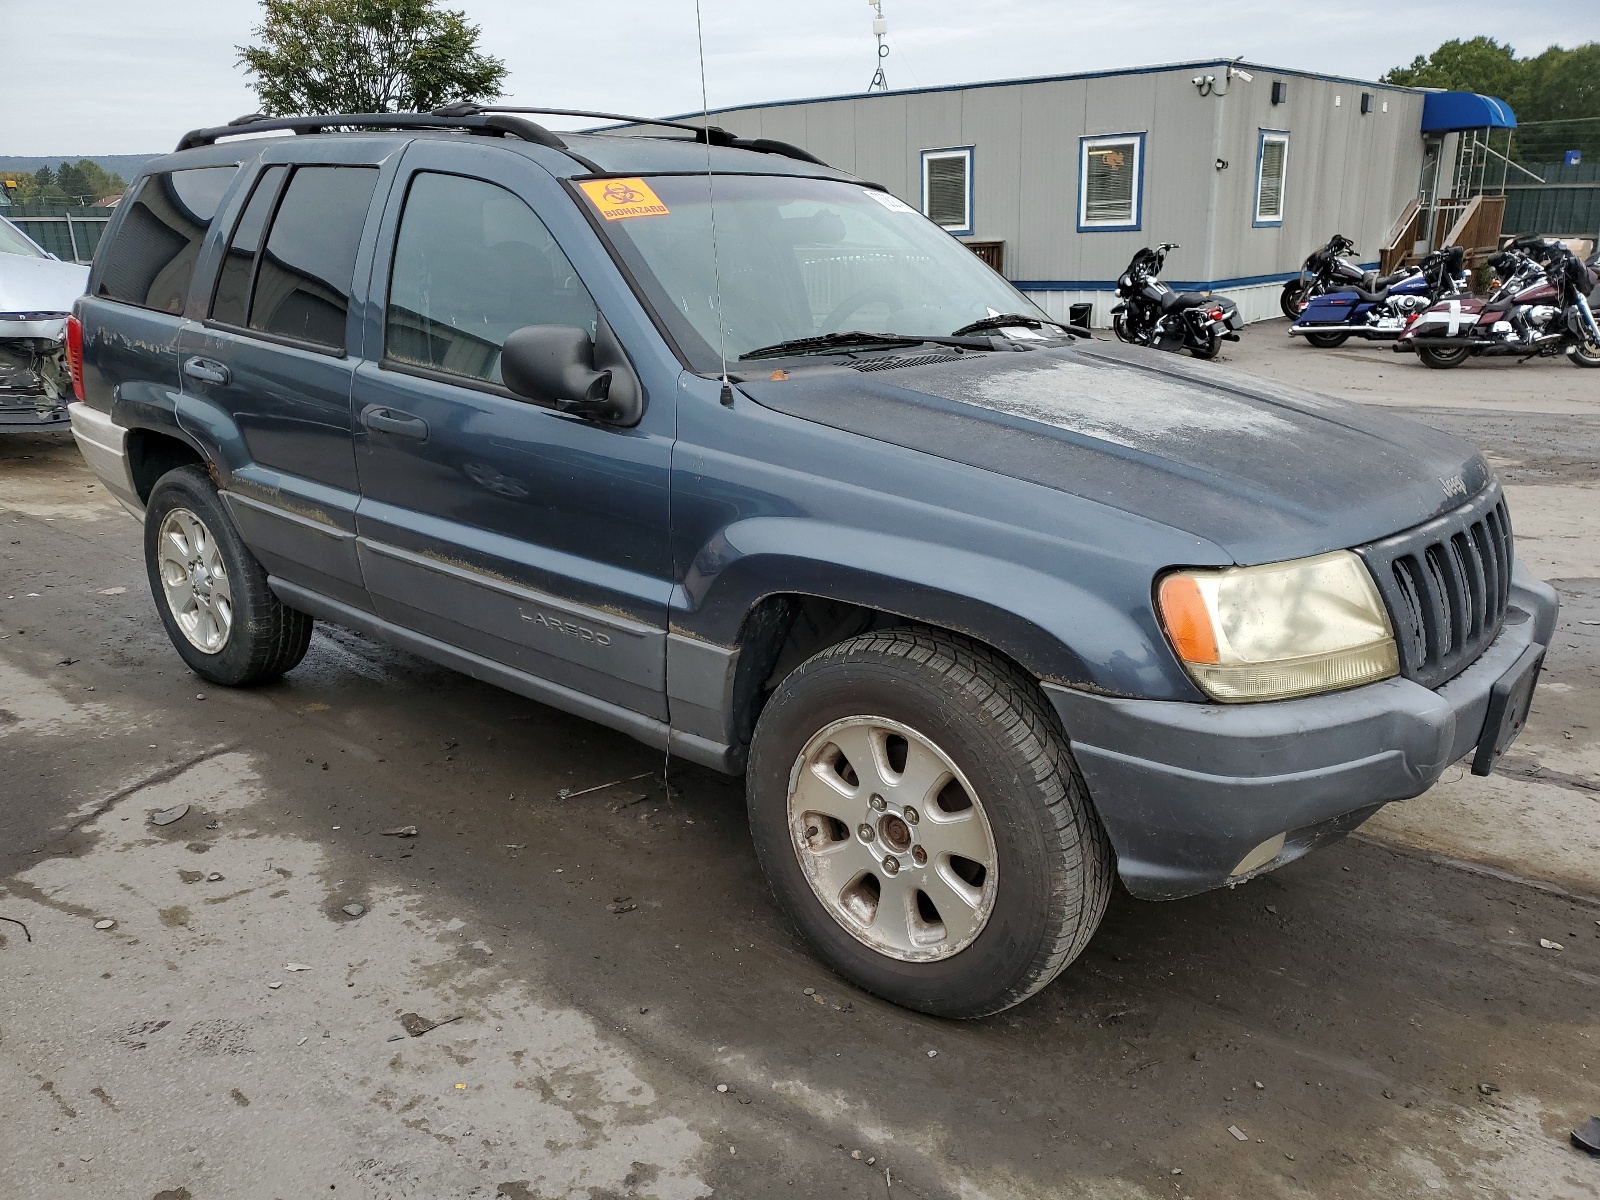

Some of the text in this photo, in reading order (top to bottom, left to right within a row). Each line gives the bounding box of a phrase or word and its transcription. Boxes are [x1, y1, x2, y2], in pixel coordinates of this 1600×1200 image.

[604, 205, 667, 217] BIOHAZARD
[1438, 475, 1467, 498] Jeep
[518, 607, 612, 647] LAREDO
